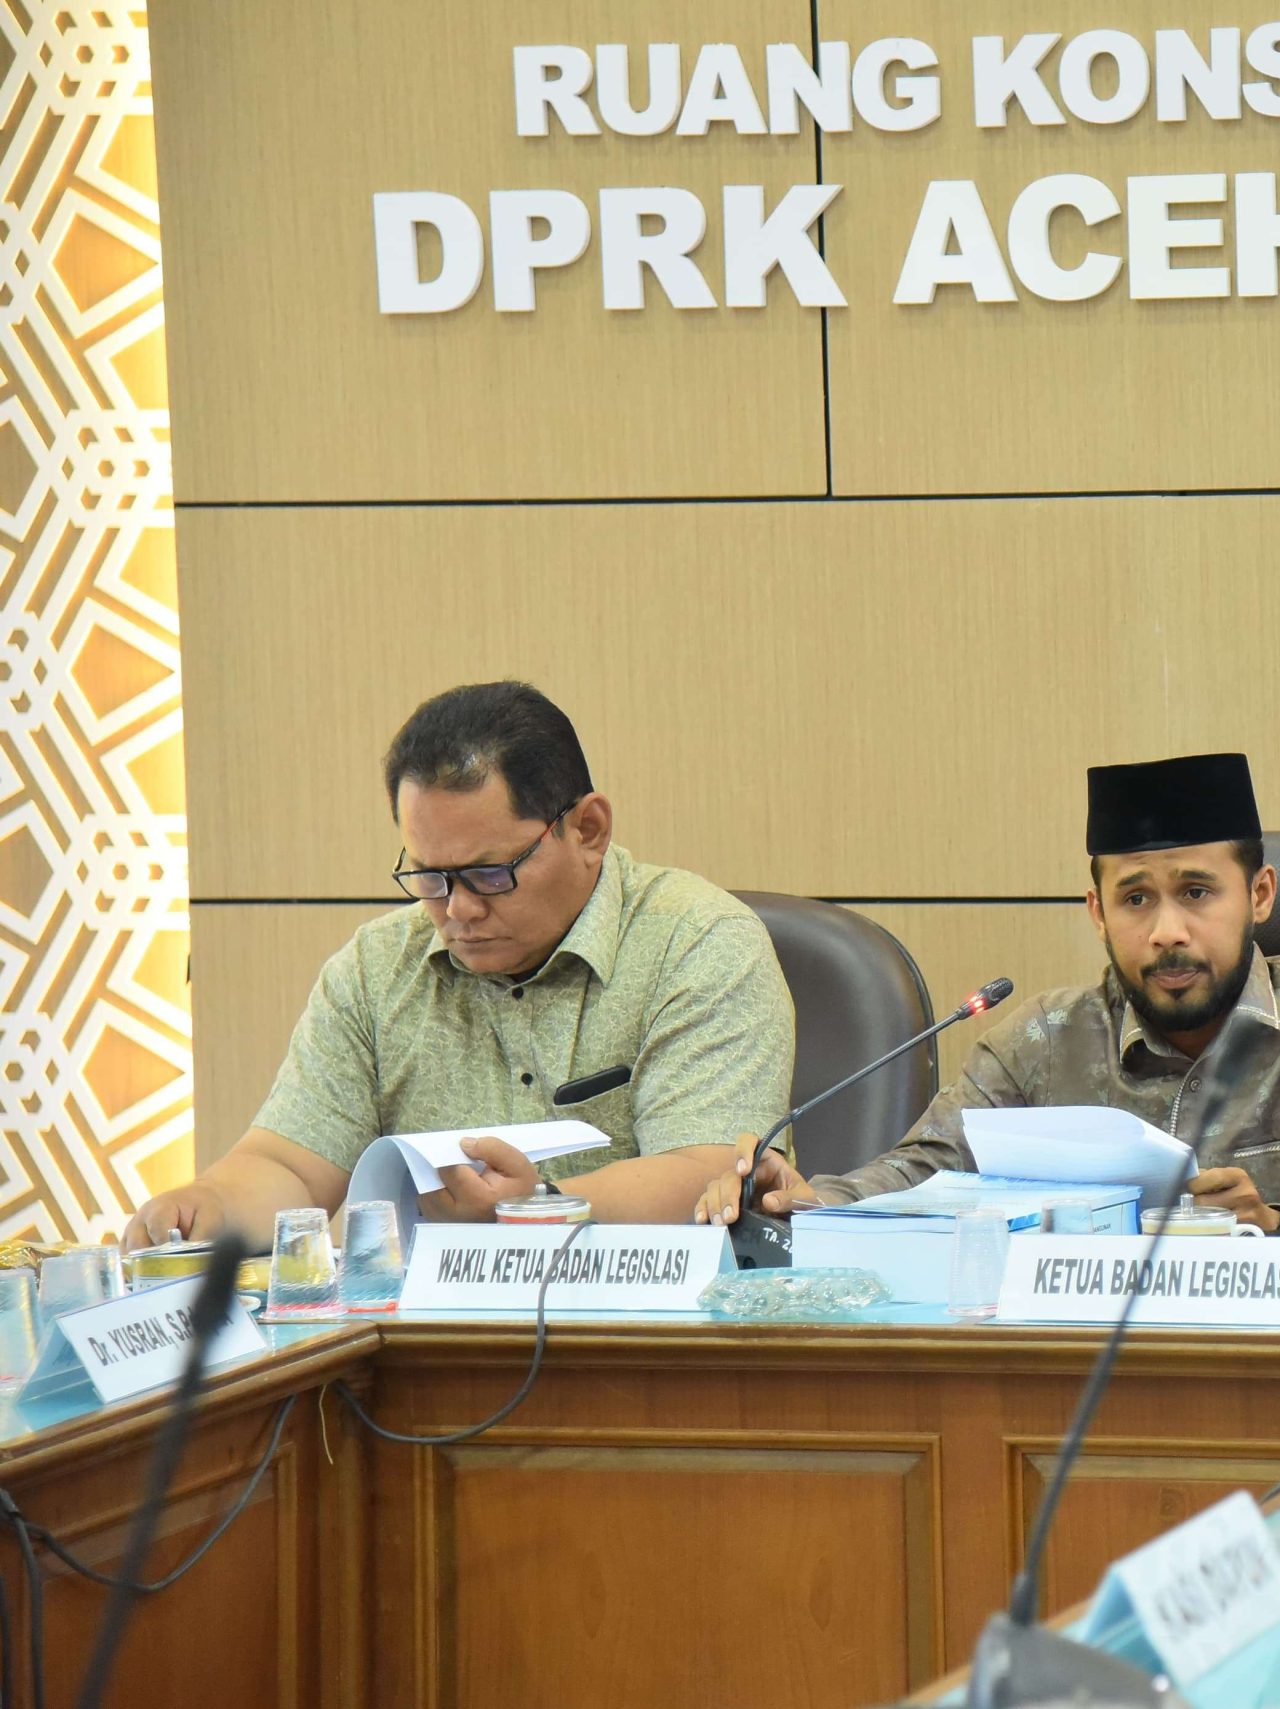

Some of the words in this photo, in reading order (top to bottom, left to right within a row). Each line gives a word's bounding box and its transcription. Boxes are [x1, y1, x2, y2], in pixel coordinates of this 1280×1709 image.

[513, 38, 942, 137] RUANG
[374, 184, 849, 315] DPRK
[436, 1248, 487, 1284] WAKIL
[491, 1248, 545, 1284] KETUA
[605, 1248, 690, 1285] LEGISLASI
[1033, 1258, 1103, 1295] KETUA
[1110, 1259, 1185, 1297] BADAN
[87, 1337, 119, 1366] Dr.
